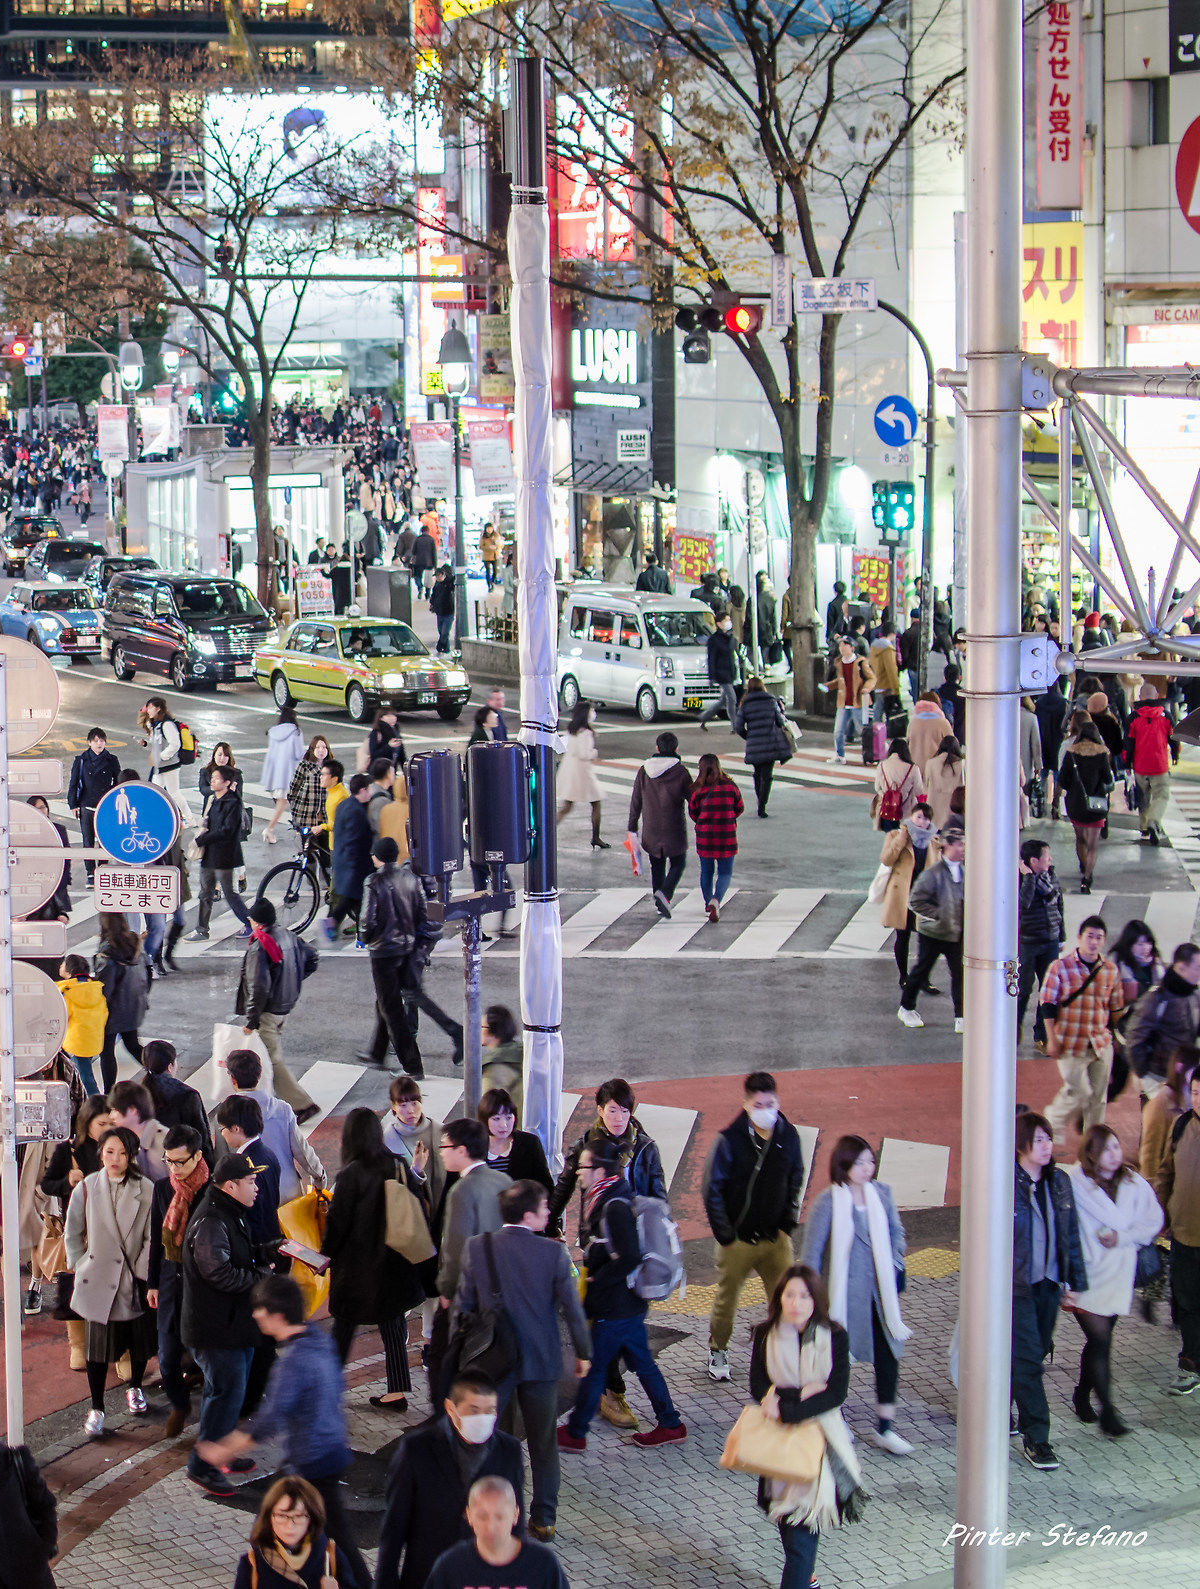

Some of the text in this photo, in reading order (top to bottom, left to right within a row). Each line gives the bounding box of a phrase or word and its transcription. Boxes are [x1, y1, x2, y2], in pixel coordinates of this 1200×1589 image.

[1048, 2, 1071, 162] 処方せん受付
[801, 282, 870, 299] 道玄坂下
[571, 328, 638, 385] LUSH
[679, 538, 709, 559] グランド
[678, 557, 709, 577] オープン
[99, 873, 173, 890] 自転車通行可
[100, 892, 172, 909] ここまで
